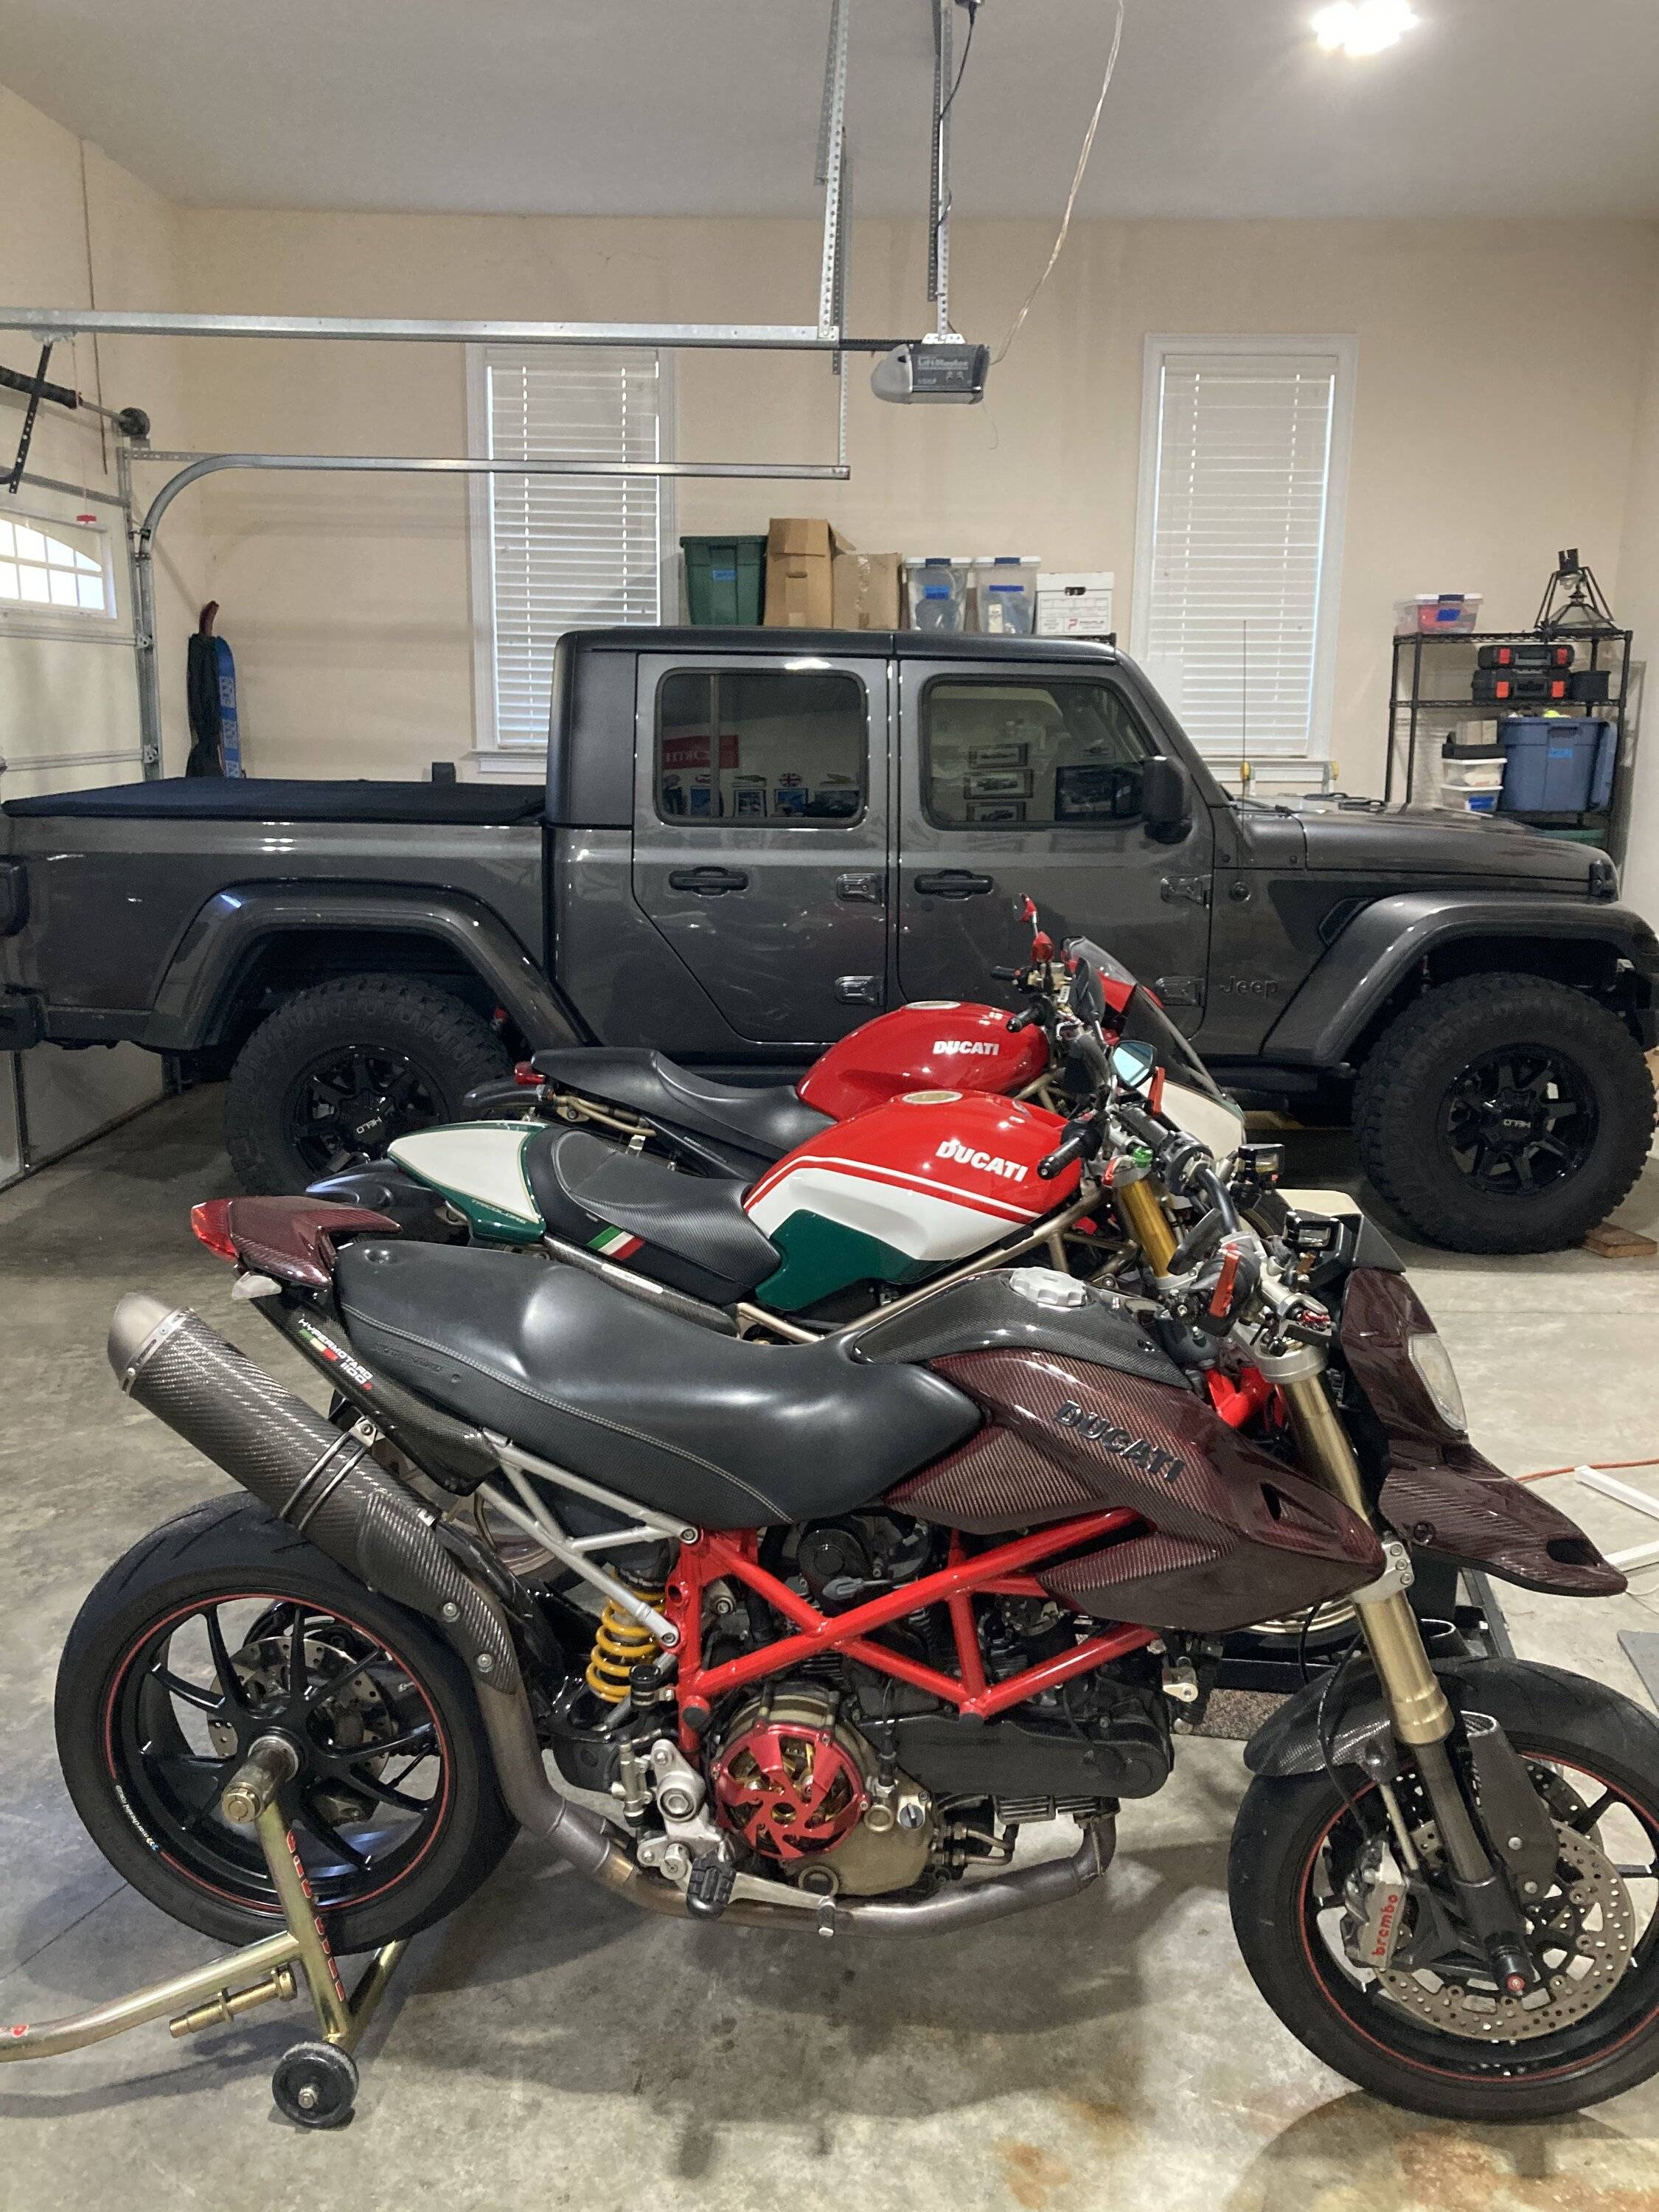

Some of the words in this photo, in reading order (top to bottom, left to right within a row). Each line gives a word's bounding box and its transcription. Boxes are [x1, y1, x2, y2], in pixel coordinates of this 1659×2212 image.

[1220, 976, 1278, 998] Jeep
[933, 1040, 999, 1055] DUCATI
[356, 1116, 382, 1134] HELO
[936, 1140, 1029, 1182] DUCATI
[298, 1318, 373, 1380] HYPERMOTARD
[340, 1361, 367, 1384] 1100
[1055, 1400, 1186, 1483] DUCATI
[122, 1804, 149, 1838] marchesini
[1371, 1894, 1399, 1956] brembo
